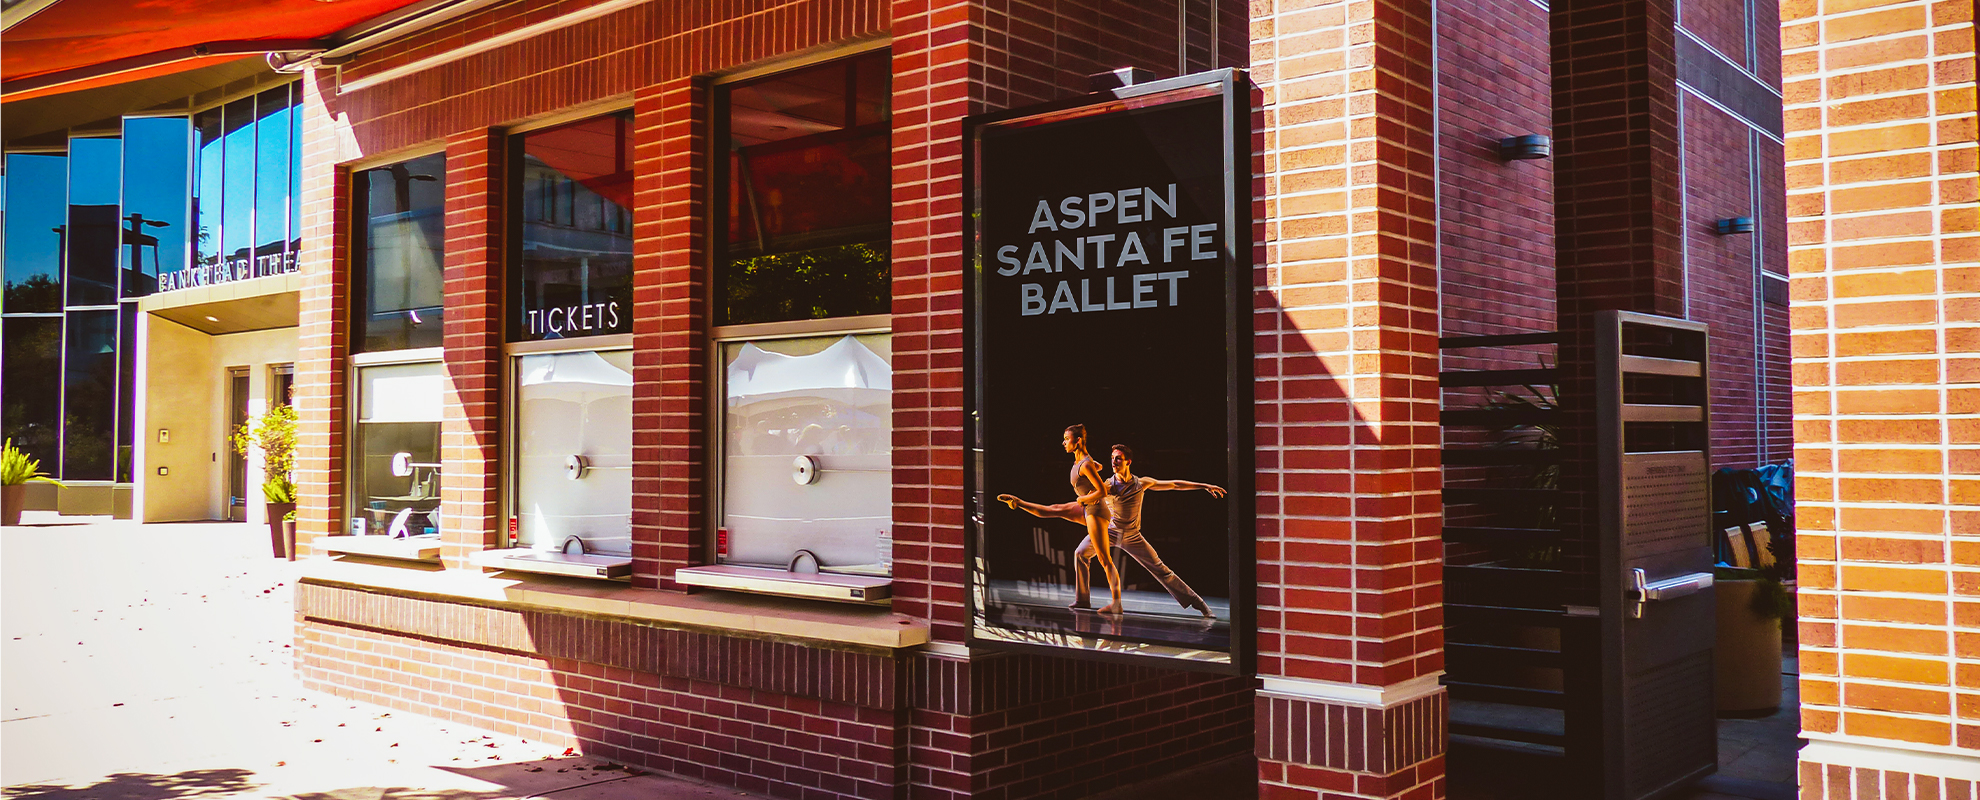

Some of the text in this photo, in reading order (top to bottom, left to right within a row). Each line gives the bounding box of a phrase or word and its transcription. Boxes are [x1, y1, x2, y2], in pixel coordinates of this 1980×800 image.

[1027, 183, 1177, 234] ASPEN
[996, 223, 1218, 277] SANTA FE
[158, 259, 249, 293] BANKHEAD
[1021, 270, 1189, 316] BALLET
[528, 301, 618, 335] TICKETS
